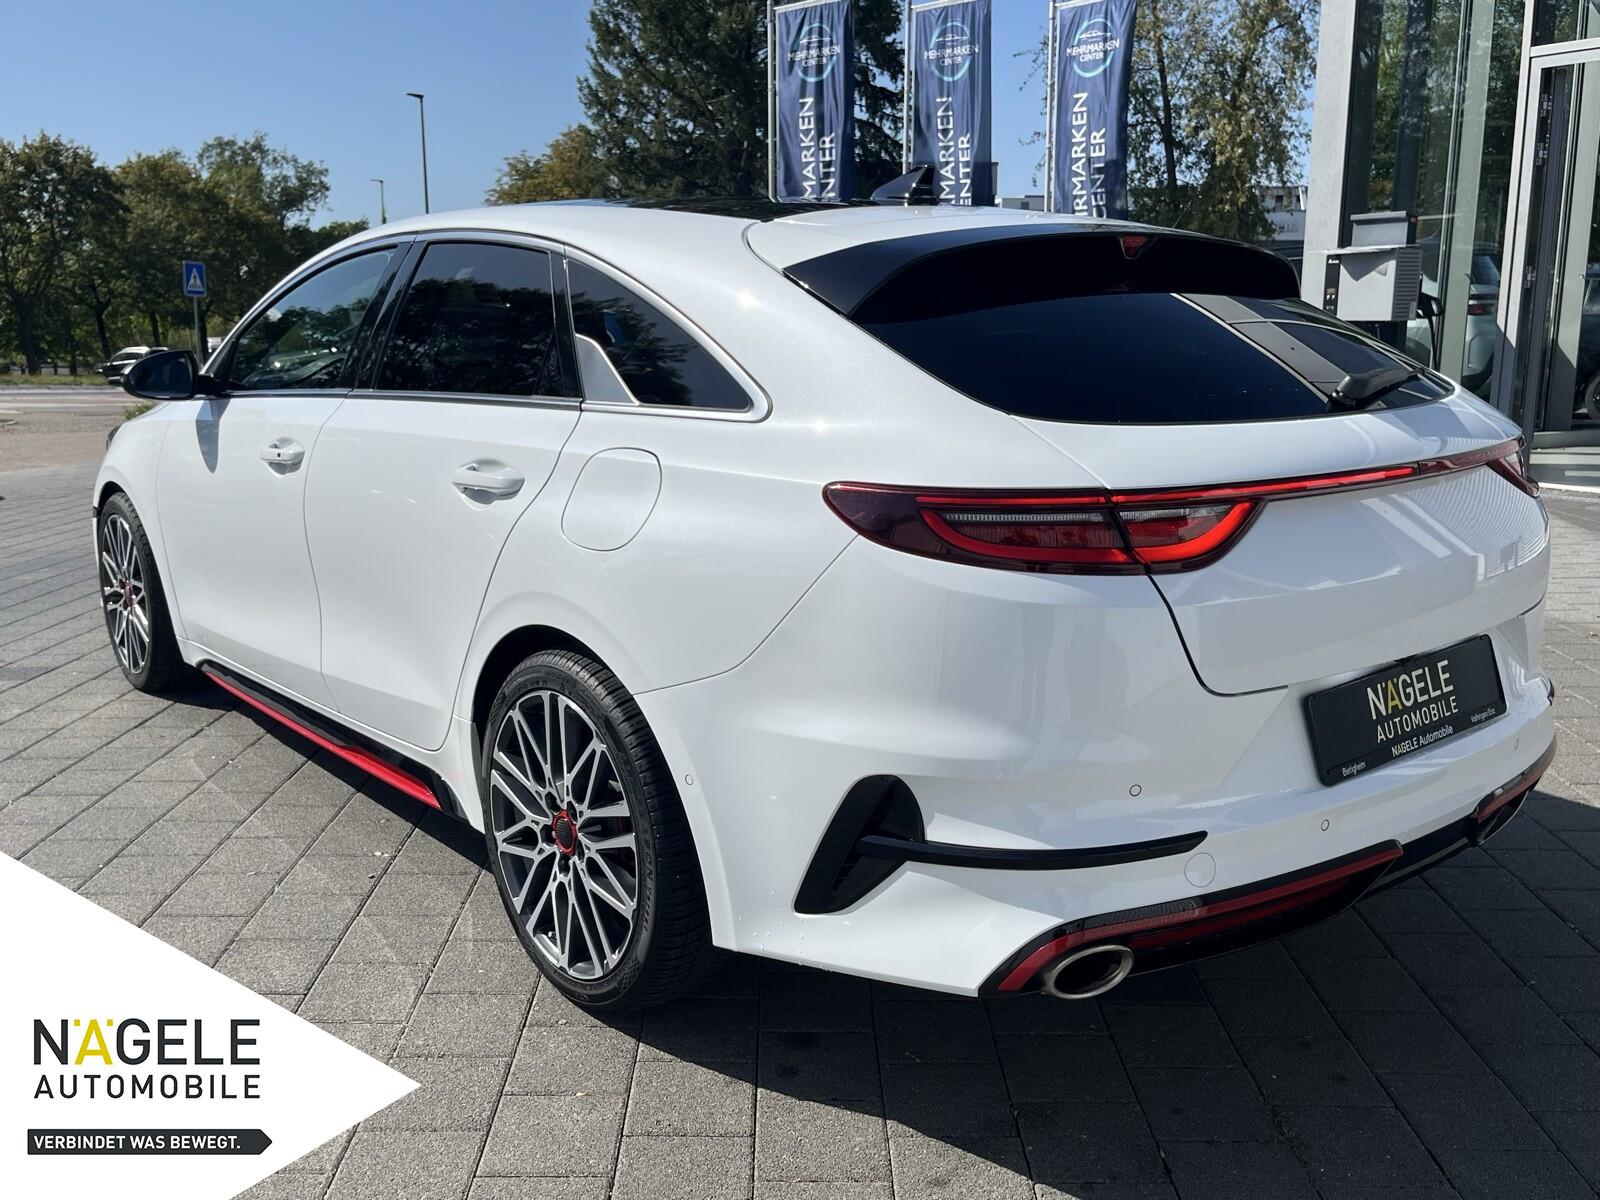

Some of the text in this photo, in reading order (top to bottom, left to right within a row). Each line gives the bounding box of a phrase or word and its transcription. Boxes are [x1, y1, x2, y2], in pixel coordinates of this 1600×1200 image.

[788, 44, 841, 62] MEHRMARKEN
[924, 44, 979, 60] MEHRMARKEN
[1066, 38, 1120, 57] MEHRMARKEN
[801, 57, 828, 67] CENTER
[940, 56, 963, 66] CENTER
[1079, 52, 1104, 63] CENTER
[936, 96, 956, 205] MARKEN
[1072, 92, 1089, 216] RMARKEN
[1367, 659, 1454, 720] NÄGELE
[1376, 695, 1459, 744] AUTOMOBILE
[1419, 723, 1455, 747] Automobile
[1341, 761, 1367, 777] Bietigheim
